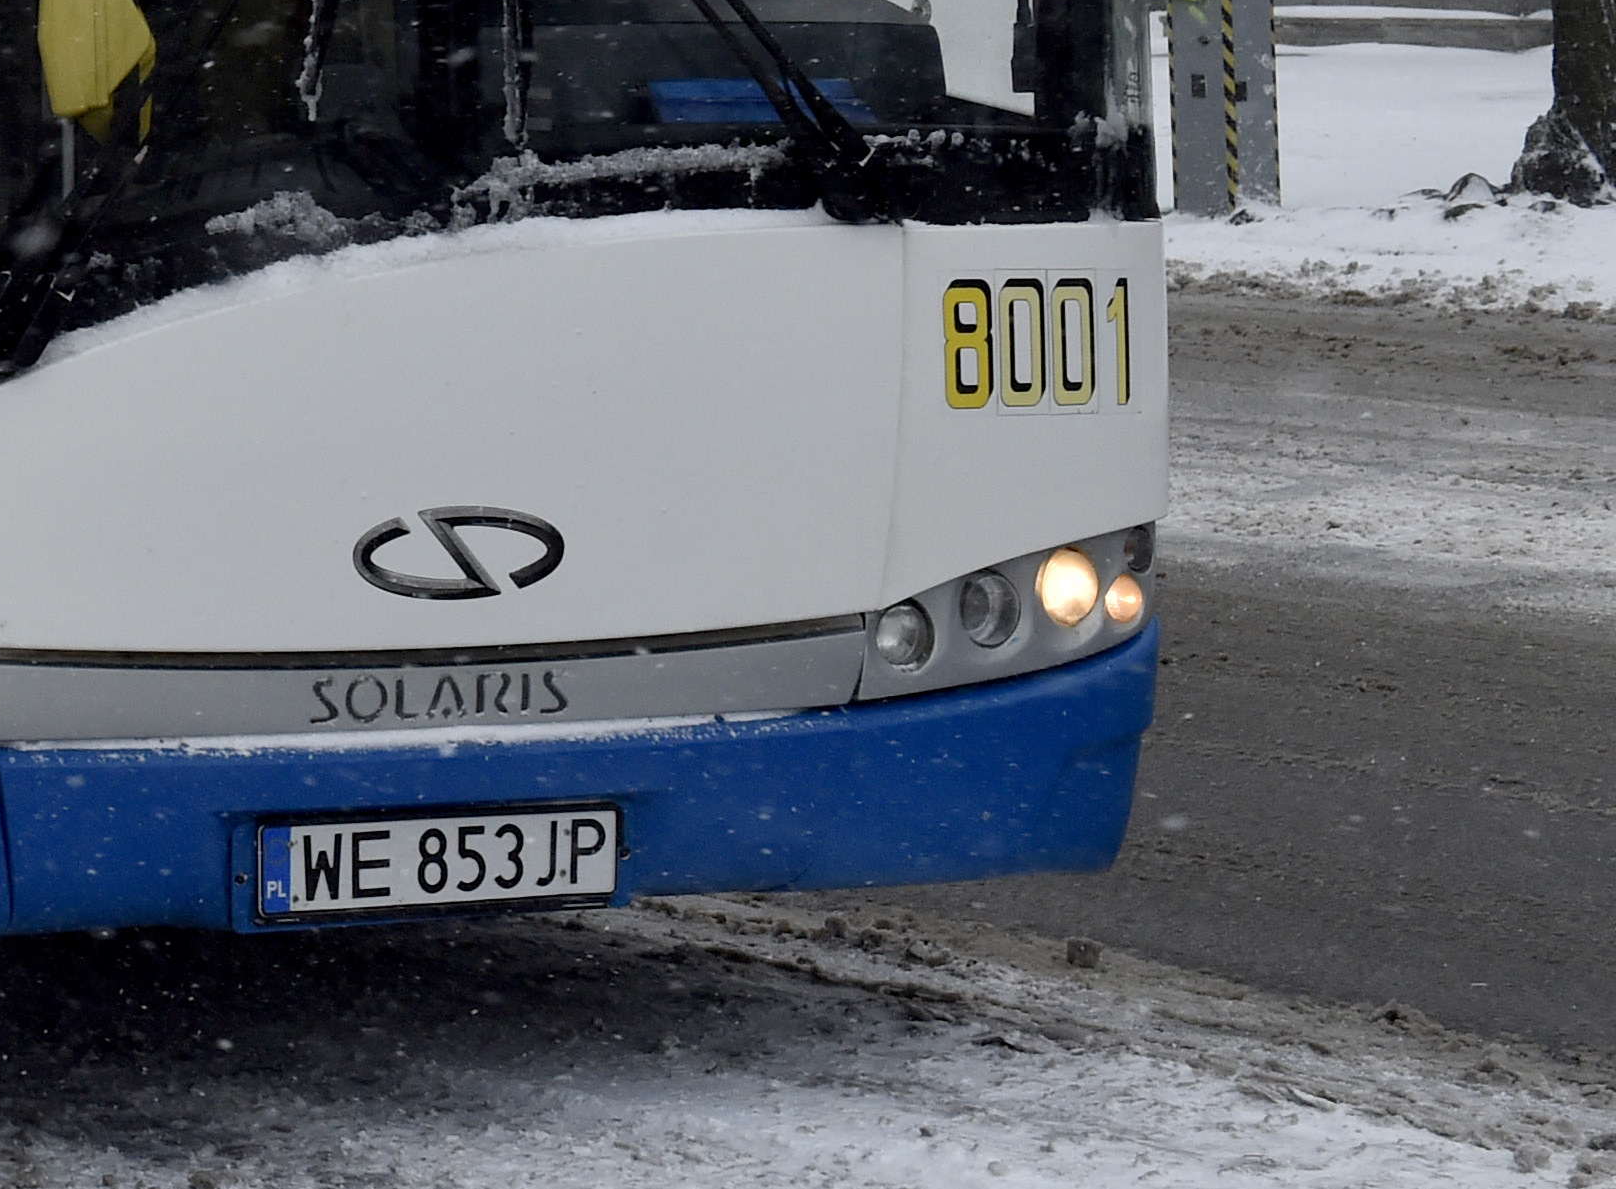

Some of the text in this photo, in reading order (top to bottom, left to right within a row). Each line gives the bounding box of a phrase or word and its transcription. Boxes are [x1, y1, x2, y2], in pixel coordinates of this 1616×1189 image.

[942, 276, 1131, 410] 8001
[309, 669, 569, 724] SOLARIS
[266, 817, 607, 902] PL WE 853JP
